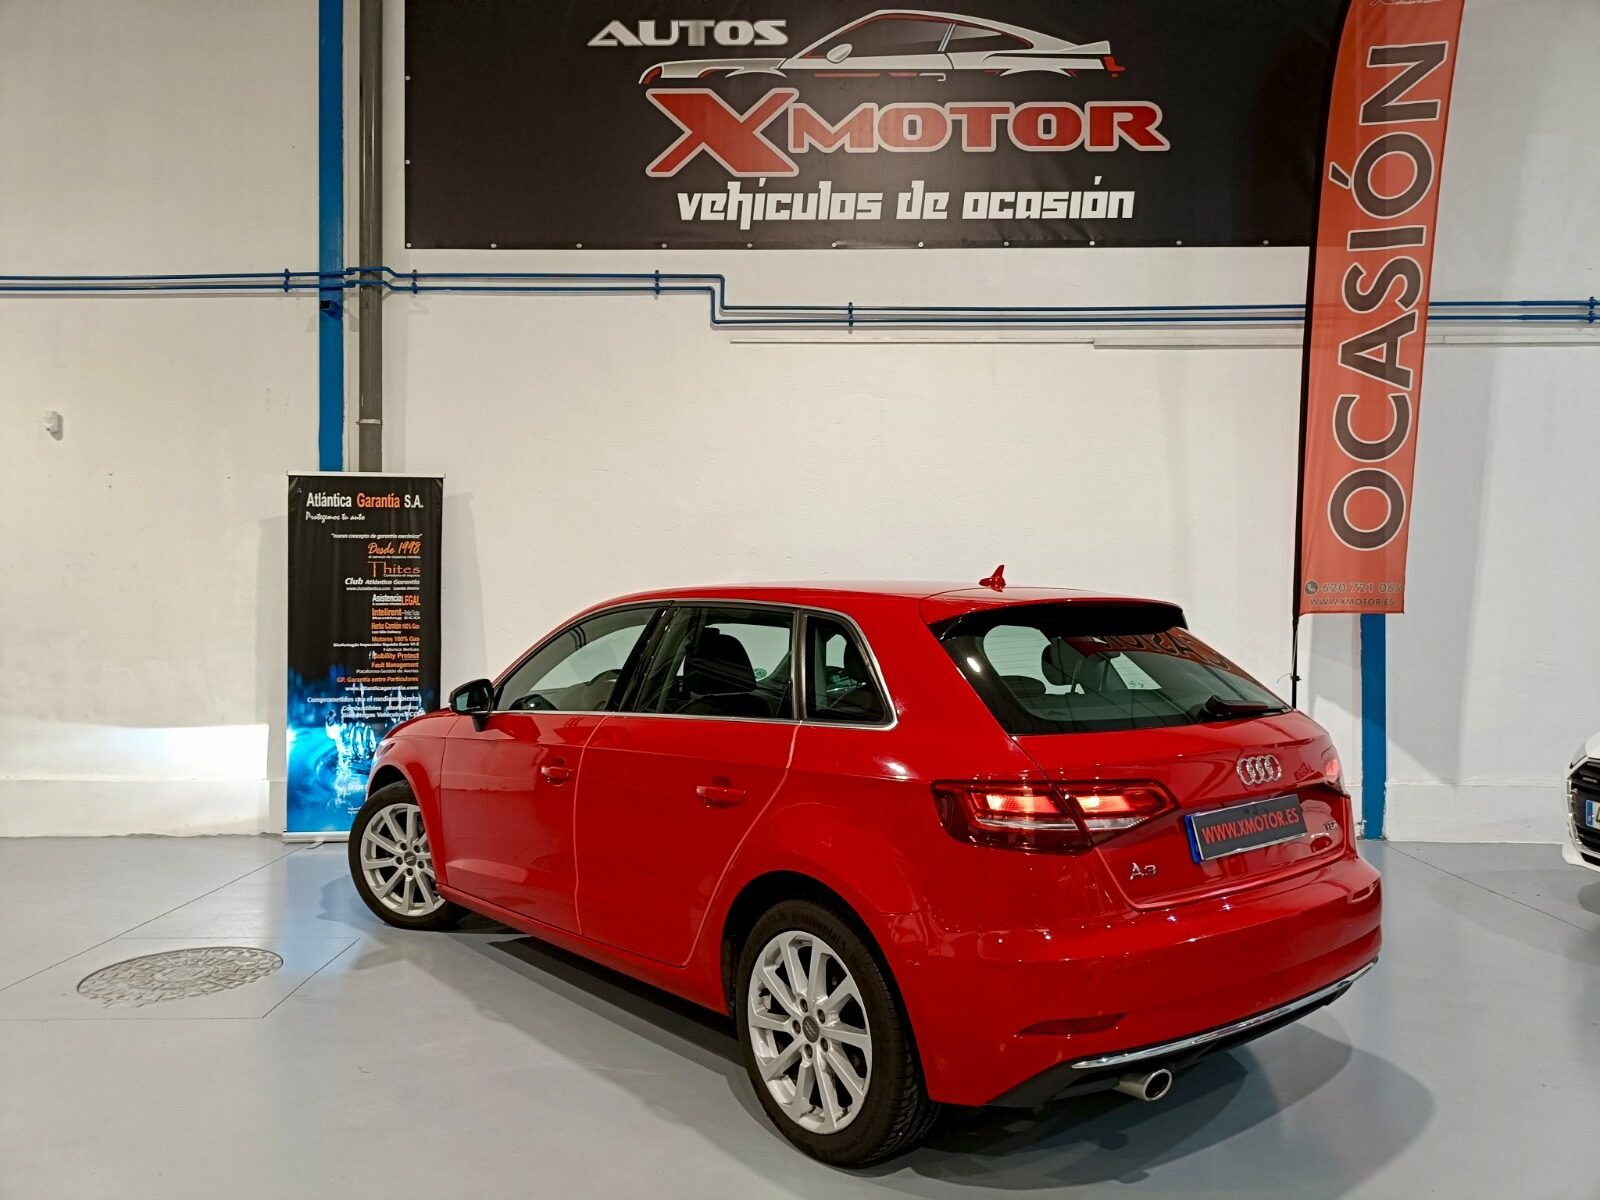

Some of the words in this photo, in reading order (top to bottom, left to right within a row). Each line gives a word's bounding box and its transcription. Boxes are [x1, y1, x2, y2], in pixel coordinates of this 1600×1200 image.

[587, 20, 788, 47] AUTOS
[645, 88, 1170, 177] XMOTOR
[677, 178, 882, 230] vehículos
[896, 179, 949, 220] de
[962, 175, 1136, 220] ocasión
[1327, 41, 1448, 551] OCASIÓN
[306, 491, 351, 508] Atlántica
[356, 492, 400, 509] Garantía
[404, 494, 424, 508] S.A.
[368, 541, 396, 554] Desde
[398, 541, 421, 554] 1998
[368, 561, 420, 577] Thites
[345, 576, 364, 585] Club
[1321, 582, 1346, 593] 620
[1350, 582, 1374, 593] 721
[1201, 807, 1300, 845] WWW.XMOTOR.ES
[1129, 862, 1156, 881] A3
